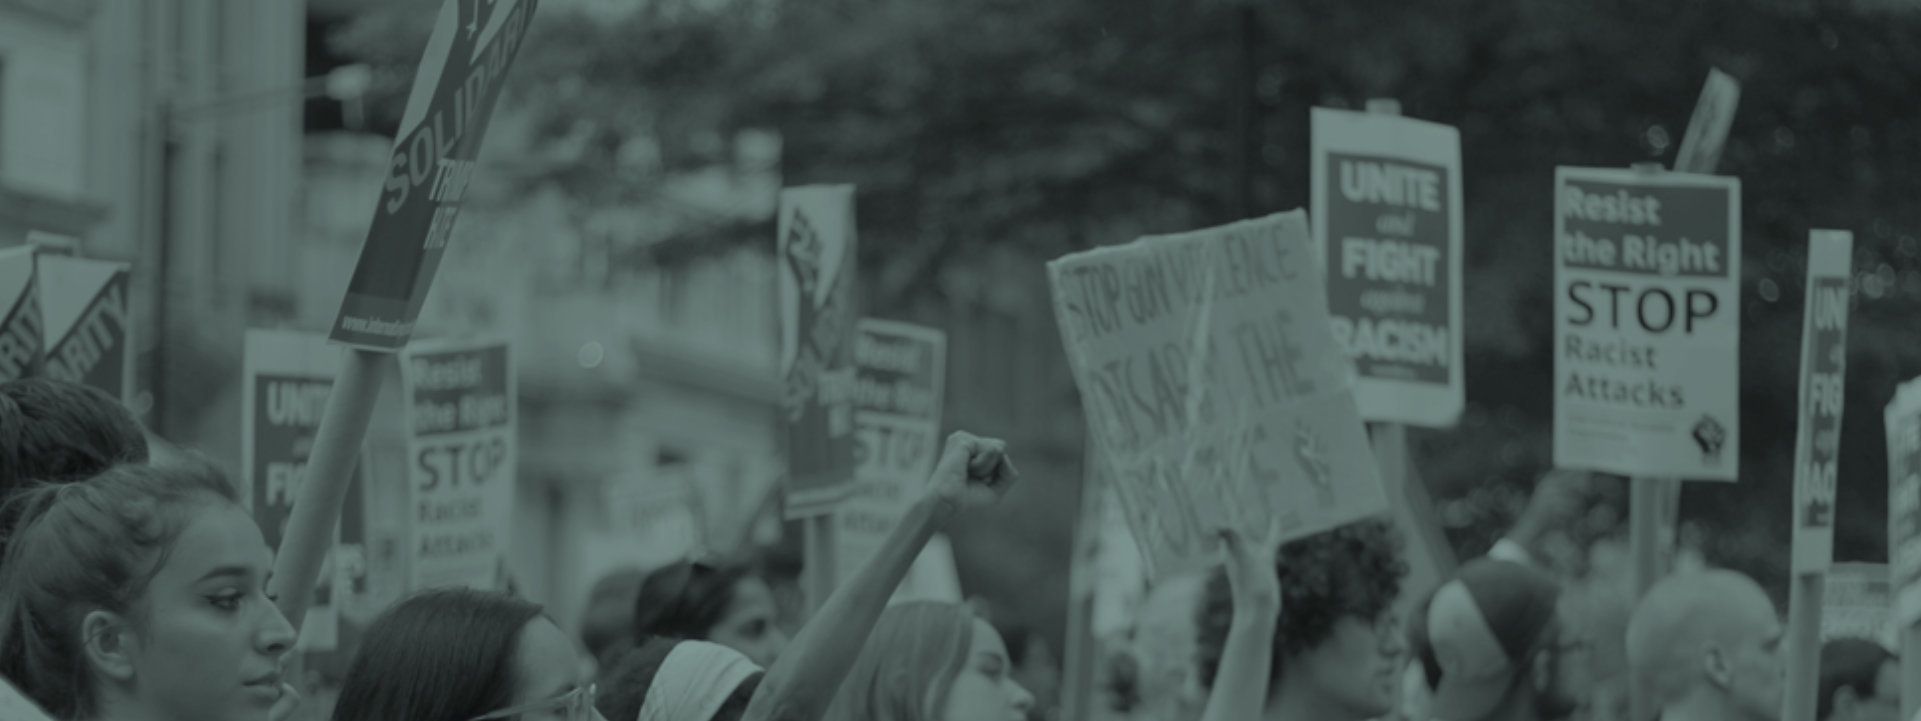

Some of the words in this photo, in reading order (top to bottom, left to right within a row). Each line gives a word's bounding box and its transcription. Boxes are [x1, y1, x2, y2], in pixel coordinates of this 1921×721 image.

[387, 0, 536, 215] SOLIDARI
[1340, 159, 1440, 212] UNITE
[1563, 186, 1662, 226] Resist
[1342, 237, 1441, 287] FIGHT
[1562, 231, 1615, 266] the
[1623, 234, 1720, 277] Right
[1566, 279, 1719, 335] STOP
[1228, 308, 1315, 408] THE
[1329, 317, 1447, 366] RACISM
[1564, 332, 1657, 370] Racist
[266, 380, 335, 426] UNIT
[1563, 371, 1686, 411] Attacks
[417, 439, 505, 493] STOP
